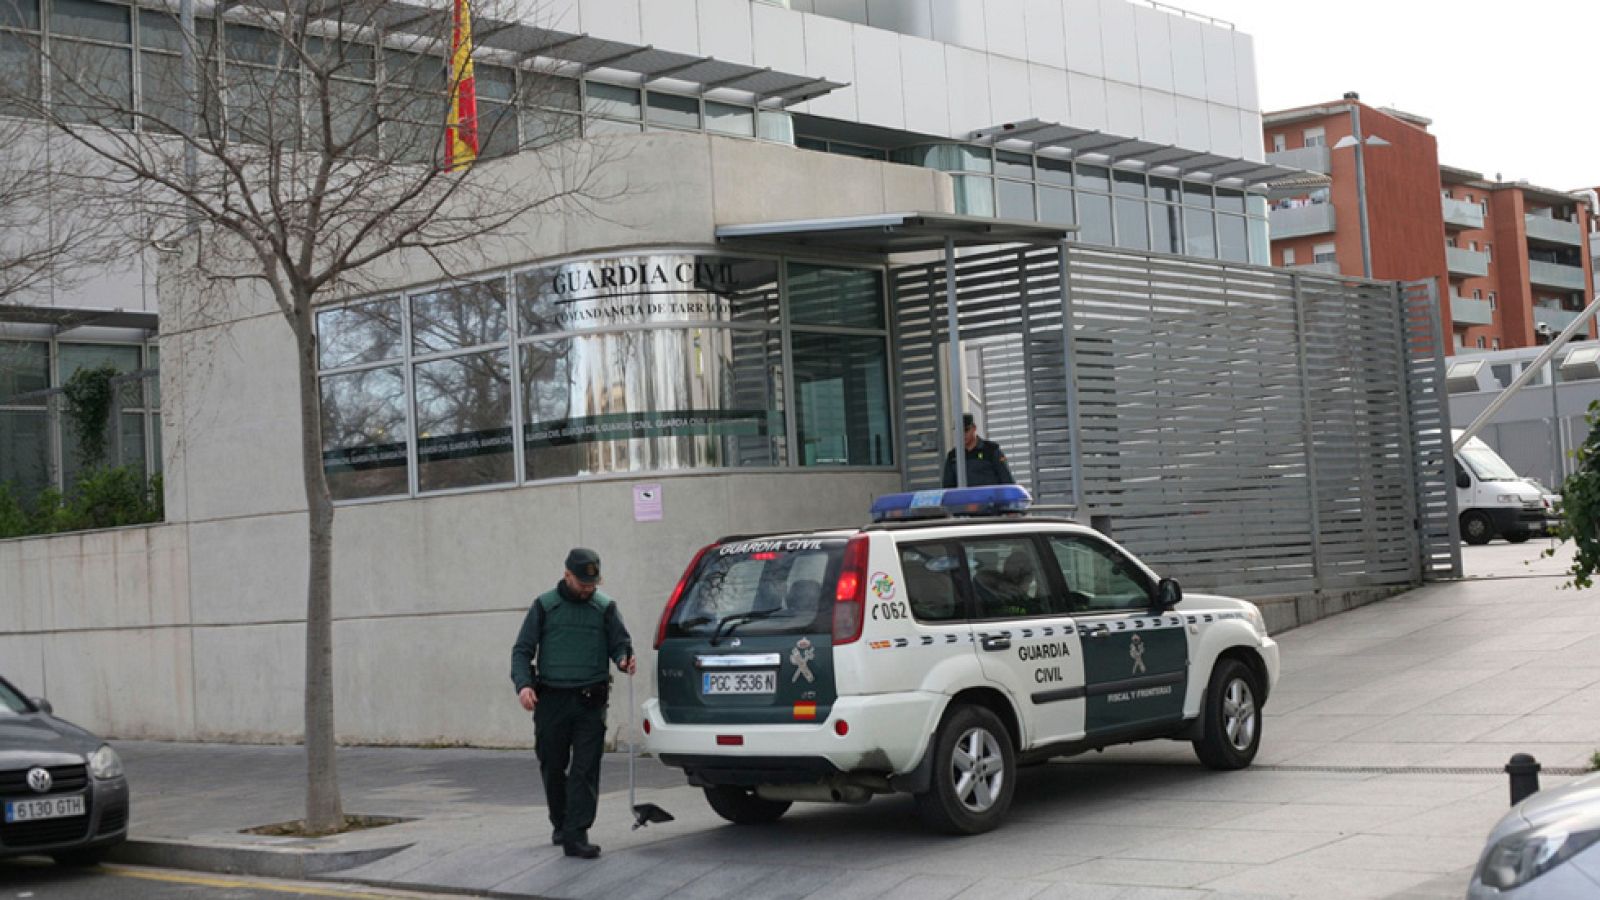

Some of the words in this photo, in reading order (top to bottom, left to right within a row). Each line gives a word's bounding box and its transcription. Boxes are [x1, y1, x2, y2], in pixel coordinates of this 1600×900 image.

[553, 263, 668, 294] GUARDIA
[675, 262, 740, 286] CIVIL
[647, 303, 664, 314] DE
[720, 541, 783, 555] GUARDIA
[786, 539, 823, 550] CIVIL
[881, 601, 908, 620] 062
[1018, 641, 1071, 662] GUARDIA
[710, 673, 731, 692] PGC
[734, 673, 763, 691] 3536
[765, 673, 775, 691] N
[1034, 666, 1064, 683] CIVIL
[17, 801, 51, 818] 6130
[56, 797, 81, 815] GTH
